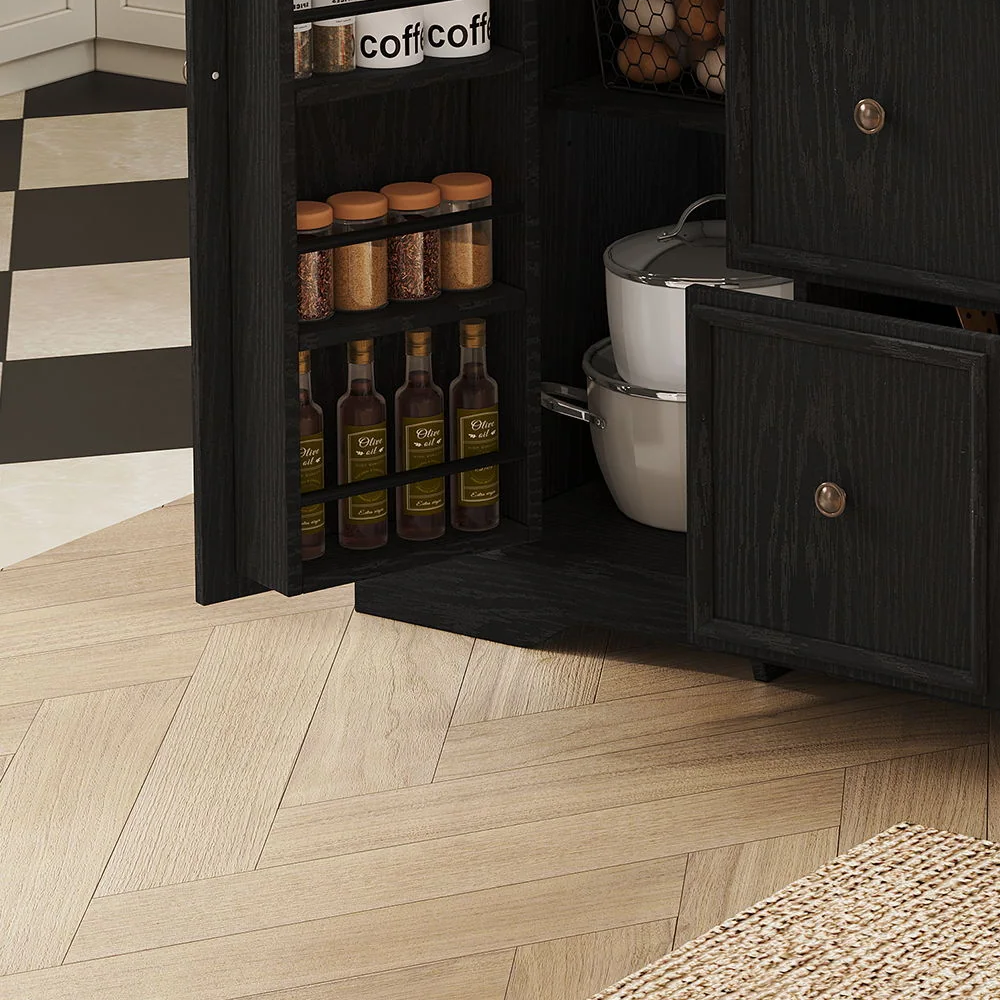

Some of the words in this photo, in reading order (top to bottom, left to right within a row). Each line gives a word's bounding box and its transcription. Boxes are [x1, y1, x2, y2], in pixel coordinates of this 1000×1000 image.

[471, 419, 495, 431] Olive
[416, 428, 440, 440] Olive
[358, 436, 383, 448] Olive
